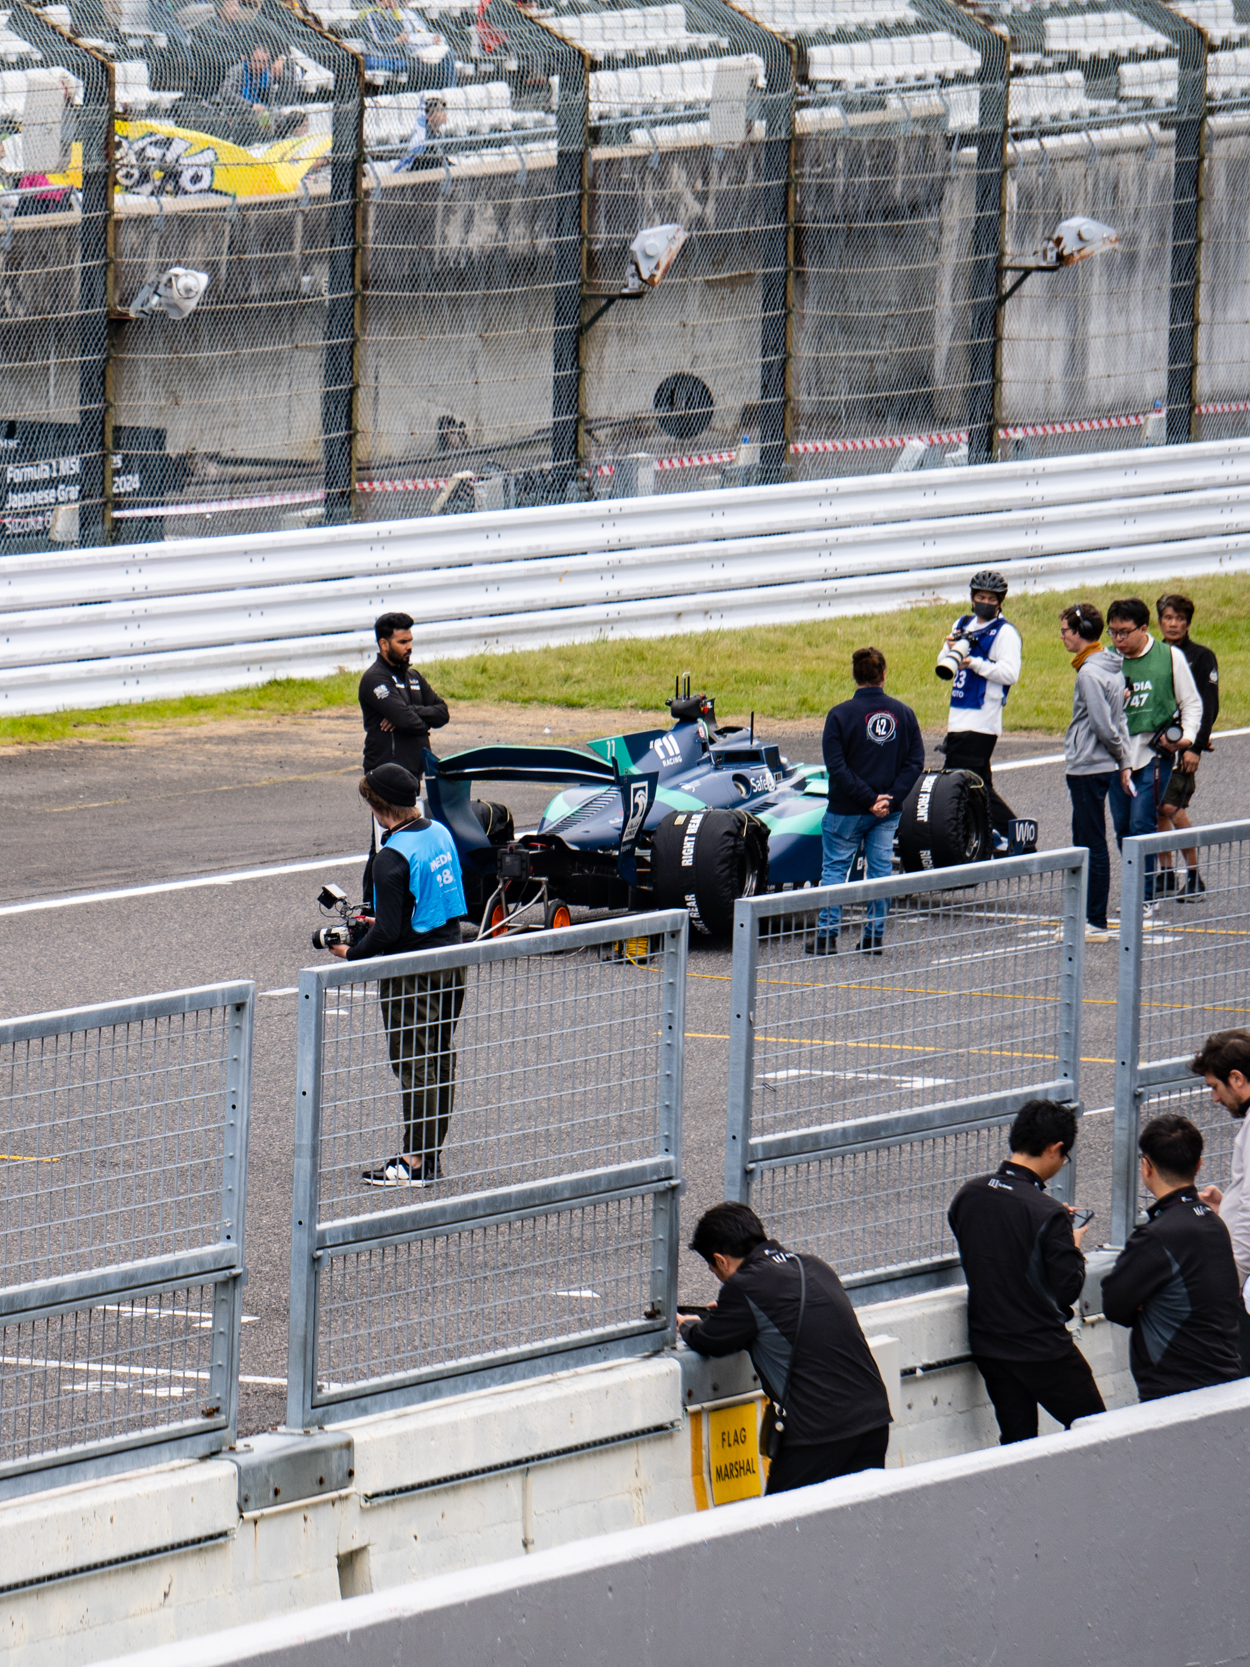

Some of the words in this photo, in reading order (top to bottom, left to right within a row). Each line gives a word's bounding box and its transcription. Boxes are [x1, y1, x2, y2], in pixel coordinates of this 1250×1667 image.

[112, 473, 141, 494] 2024
[1132, 680, 1153, 692] DIA
[875, 718, 887, 736] 42
[662, 755, 683, 767] RACING
[917, 793, 930, 822] FRONT
[430, 851, 453, 872] MEDA
[681, 835, 696, 867] RIGHT
[721, 1426, 747, 1448] FLAG
[715, 1457, 756, 1483] MARSHAL
